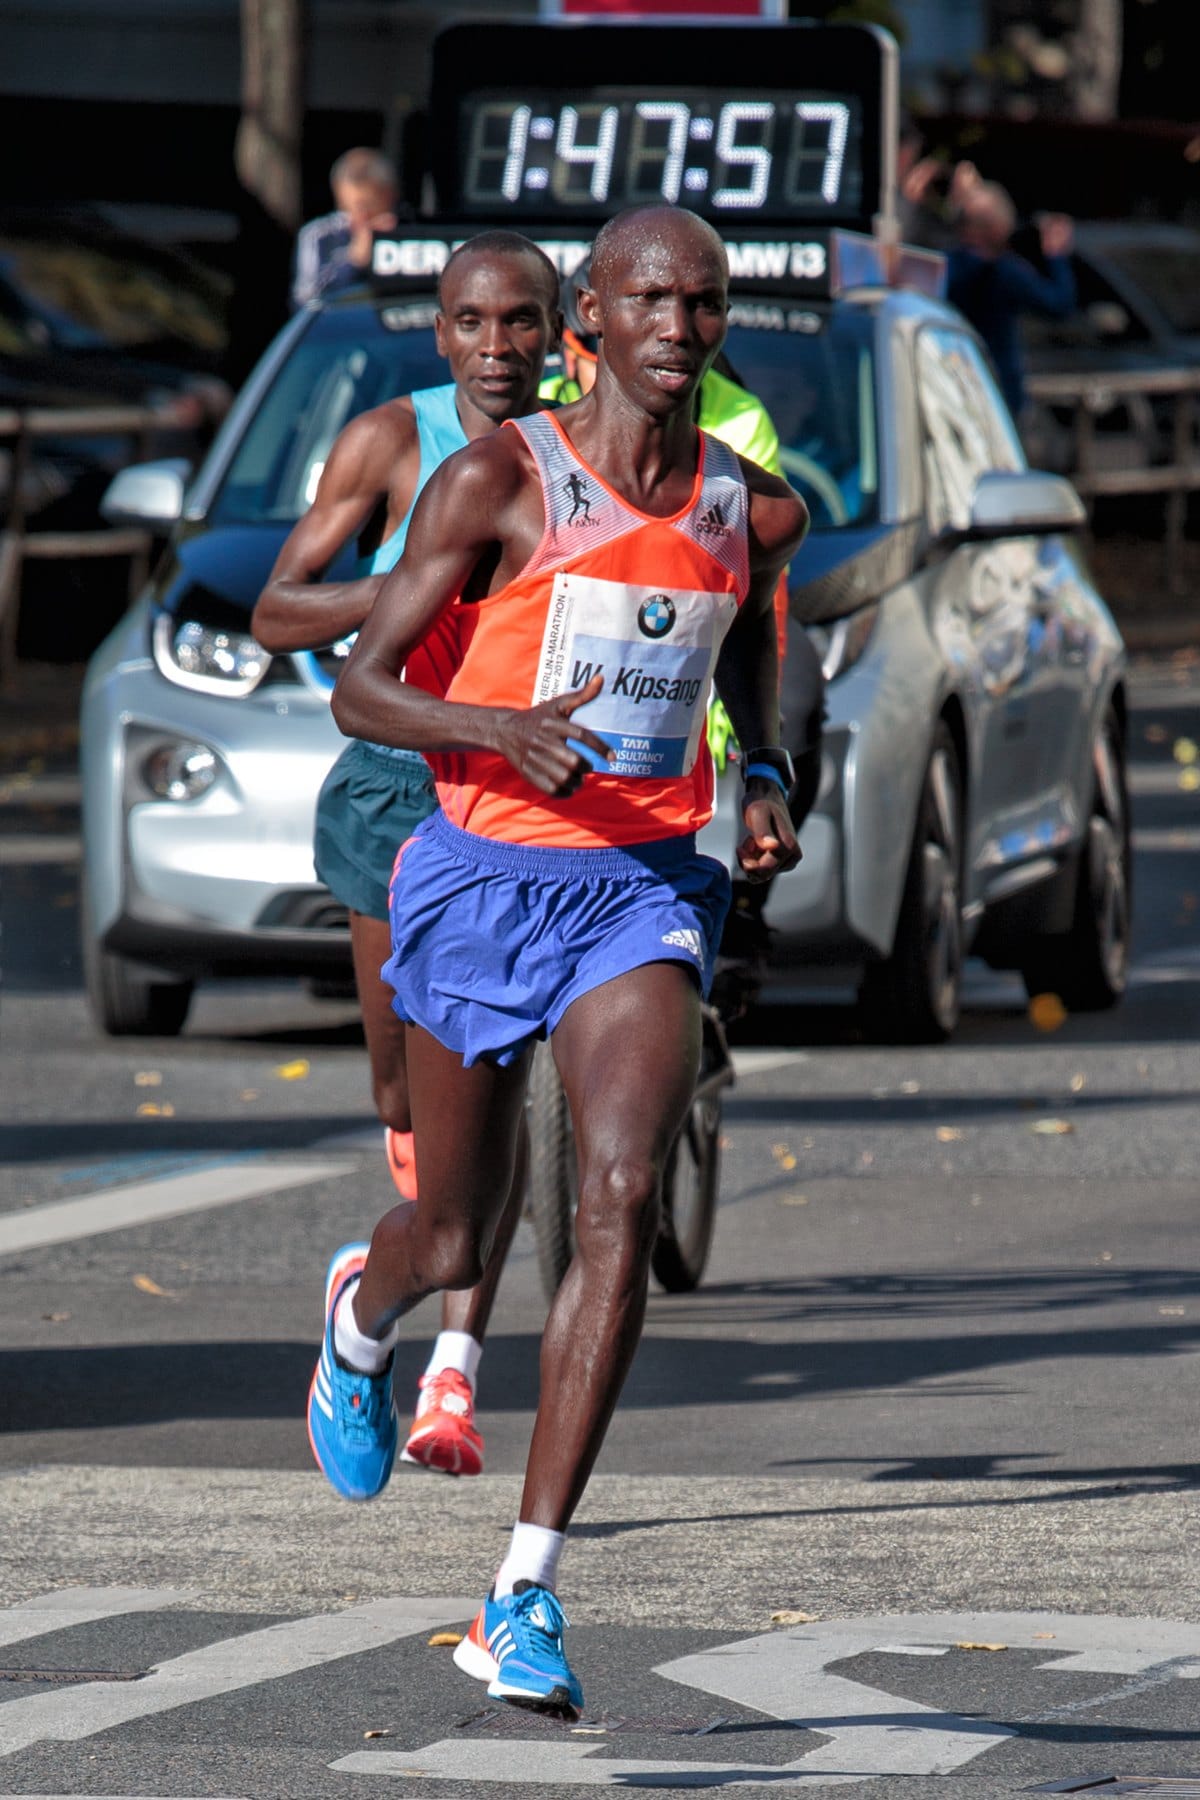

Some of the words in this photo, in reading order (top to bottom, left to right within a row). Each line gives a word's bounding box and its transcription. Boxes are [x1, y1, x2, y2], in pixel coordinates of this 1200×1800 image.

[502, 102, 849, 207] 1:47:57
[373, 240, 449, 275] DER
[723, 242, 789, 278] MW
[790, 242, 826, 278] i3
[696, 521, 731, 538] adidas
[541, 594, 566, 697] BERLIN-MARATHON
[554, 654, 565, 677] 2013
[611, 667, 701, 706] Kipsang
[621, 737, 650, 750] TATA
[613, 749, 664, 763] NSULTANCY
[609, 761, 652, 775] SERVICES
